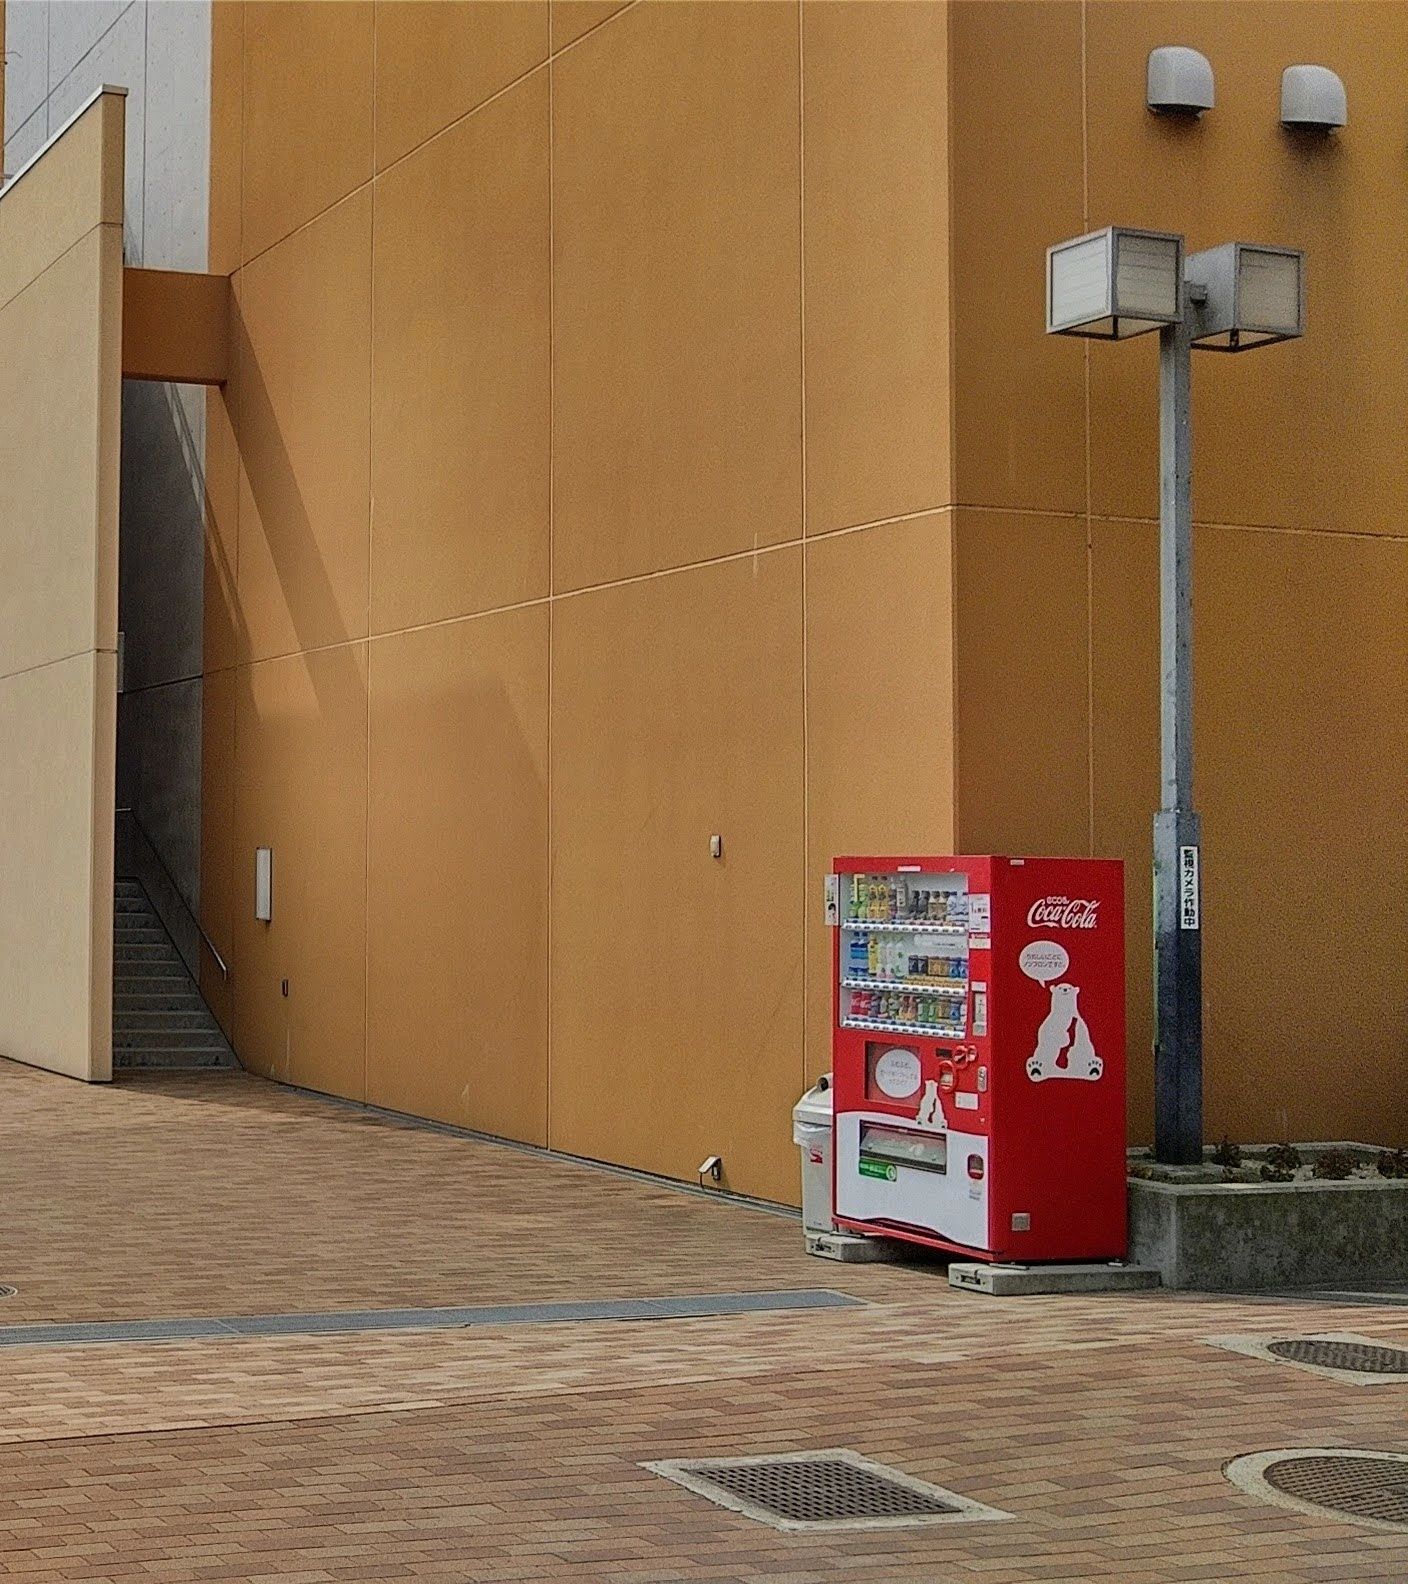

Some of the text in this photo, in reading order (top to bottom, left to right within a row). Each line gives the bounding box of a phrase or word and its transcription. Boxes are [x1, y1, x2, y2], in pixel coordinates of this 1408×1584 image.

[1027, 899, 1101, 929] Coca-Cola
[1183, 849, 1196, 927] 監視カメラ作動中
